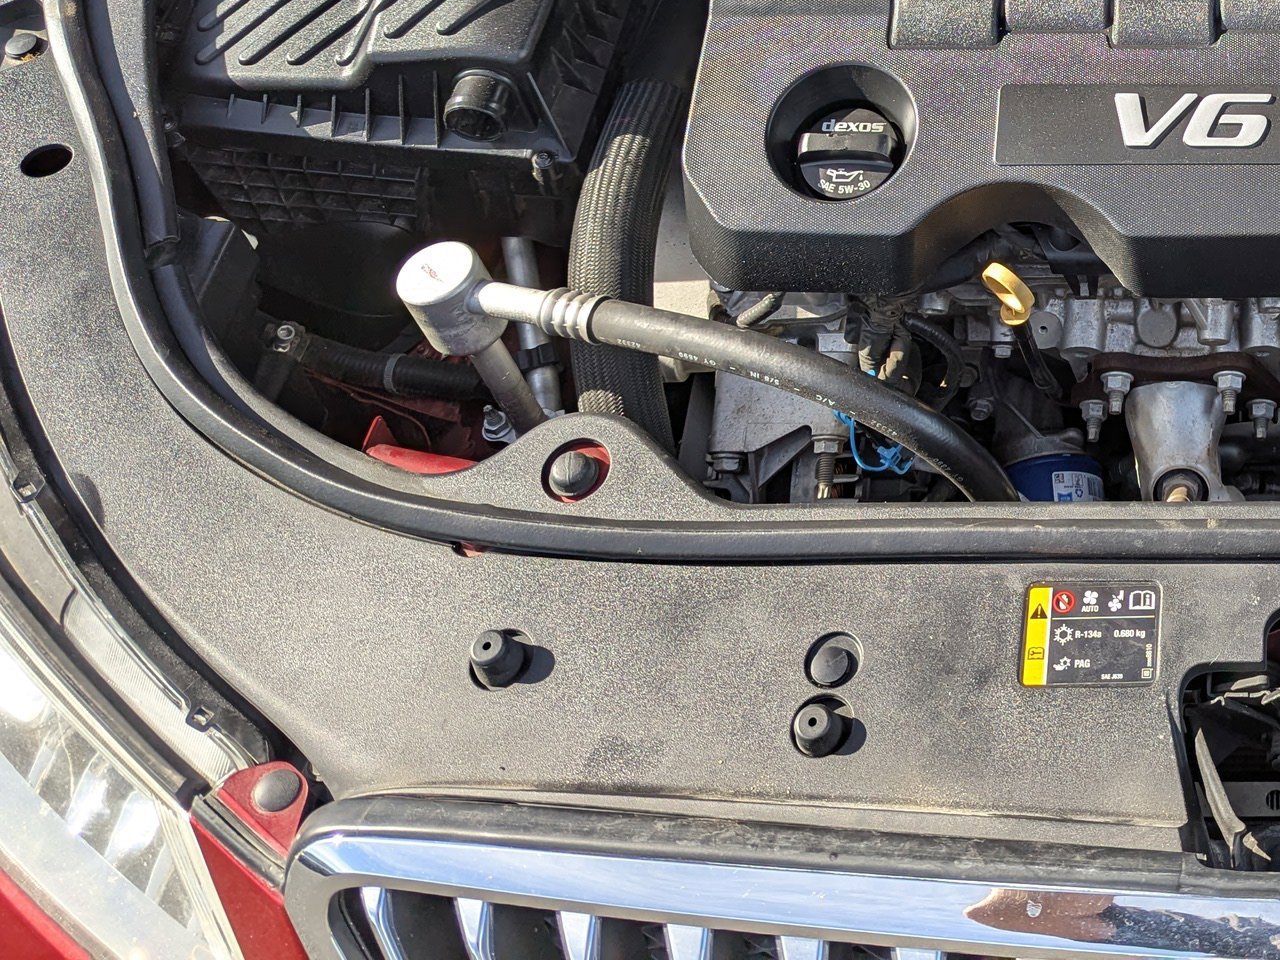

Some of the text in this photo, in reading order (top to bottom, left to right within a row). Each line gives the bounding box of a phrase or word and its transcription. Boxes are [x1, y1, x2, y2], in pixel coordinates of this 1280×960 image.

[821, 119, 885, 133] dexos
[1114, 93, 1274, 148] V6
[818, 179, 871, 194] SAE 5W-30
[815, 394, 836, 406] A/C
[1081, 605, 1099, 613] AUTO
[1075, 629, 1146, 639] R-134a 0.680 kg
[1074, 659, 1091, 669] PAG
